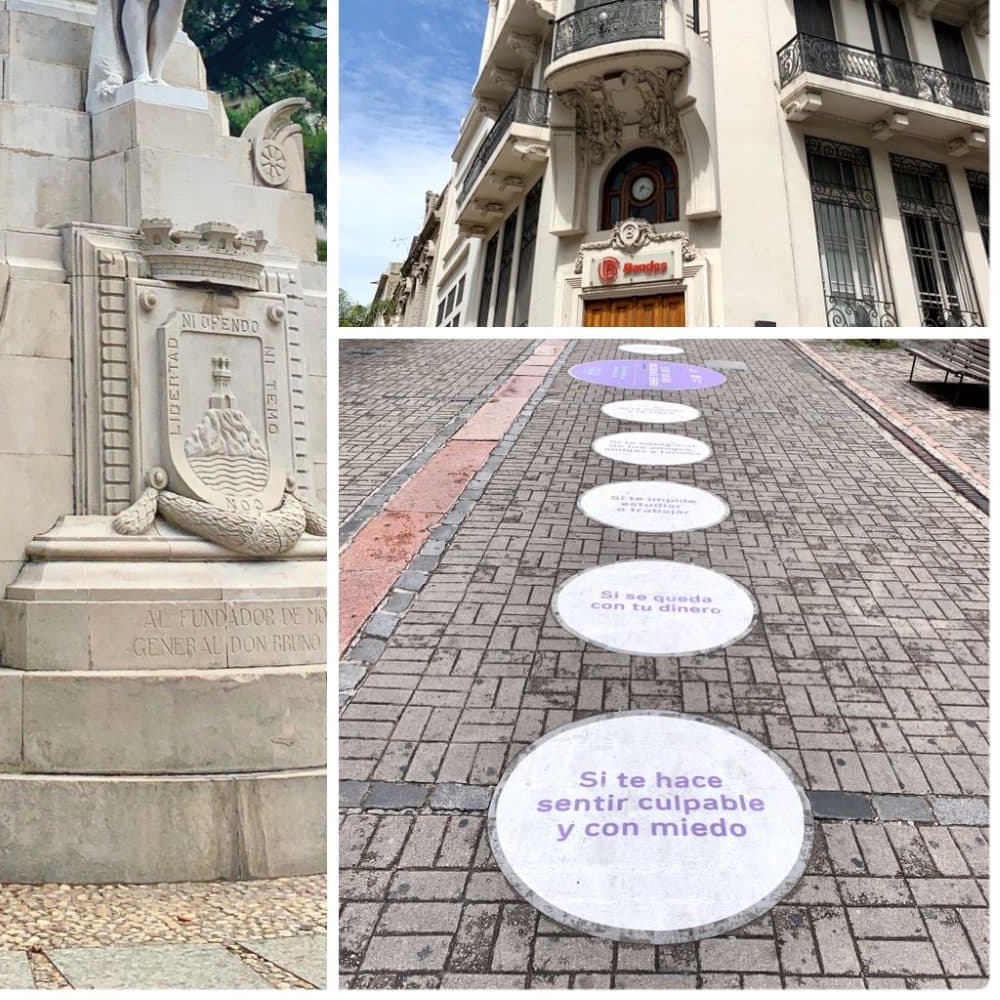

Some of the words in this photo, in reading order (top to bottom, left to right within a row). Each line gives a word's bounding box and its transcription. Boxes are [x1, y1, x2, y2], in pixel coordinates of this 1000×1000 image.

[182, 313, 195, 329] NI
[201, 315, 259, 333] OFENDO
[264, 345, 275, 365] NI
[167, 337, 181, 436] LIBERTAD
[266, 380, 279, 434] TEMO
[601, 590, 618, 599] Si
[625, 593, 647, 601] se
[653, 594, 712, 603] queda
[144, 609, 169, 629] AL
[179, 607, 275, 629] FUNDADOR
[281, 606, 301, 626] DE
[591, 602, 625, 610] con
[632, 603, 652, 611] tu
[659, 603, 721, 614] dinero
[133, 636, 221, 657] GENERAL
[230, 635, 266, 654] DON
[272, 634, 321, 653] BRUNO
[579, 771, 606, 788] Si
[617, 772, 646, 788] te
[656, 772, 724, 788] hace
[537, 794, 629, 812] sentir
[638, 794, 766, 815] culpable
[557, 823, 575, 841] y
[585, 820, 639, 837] con
[651, 817, 747, 838] miedo
